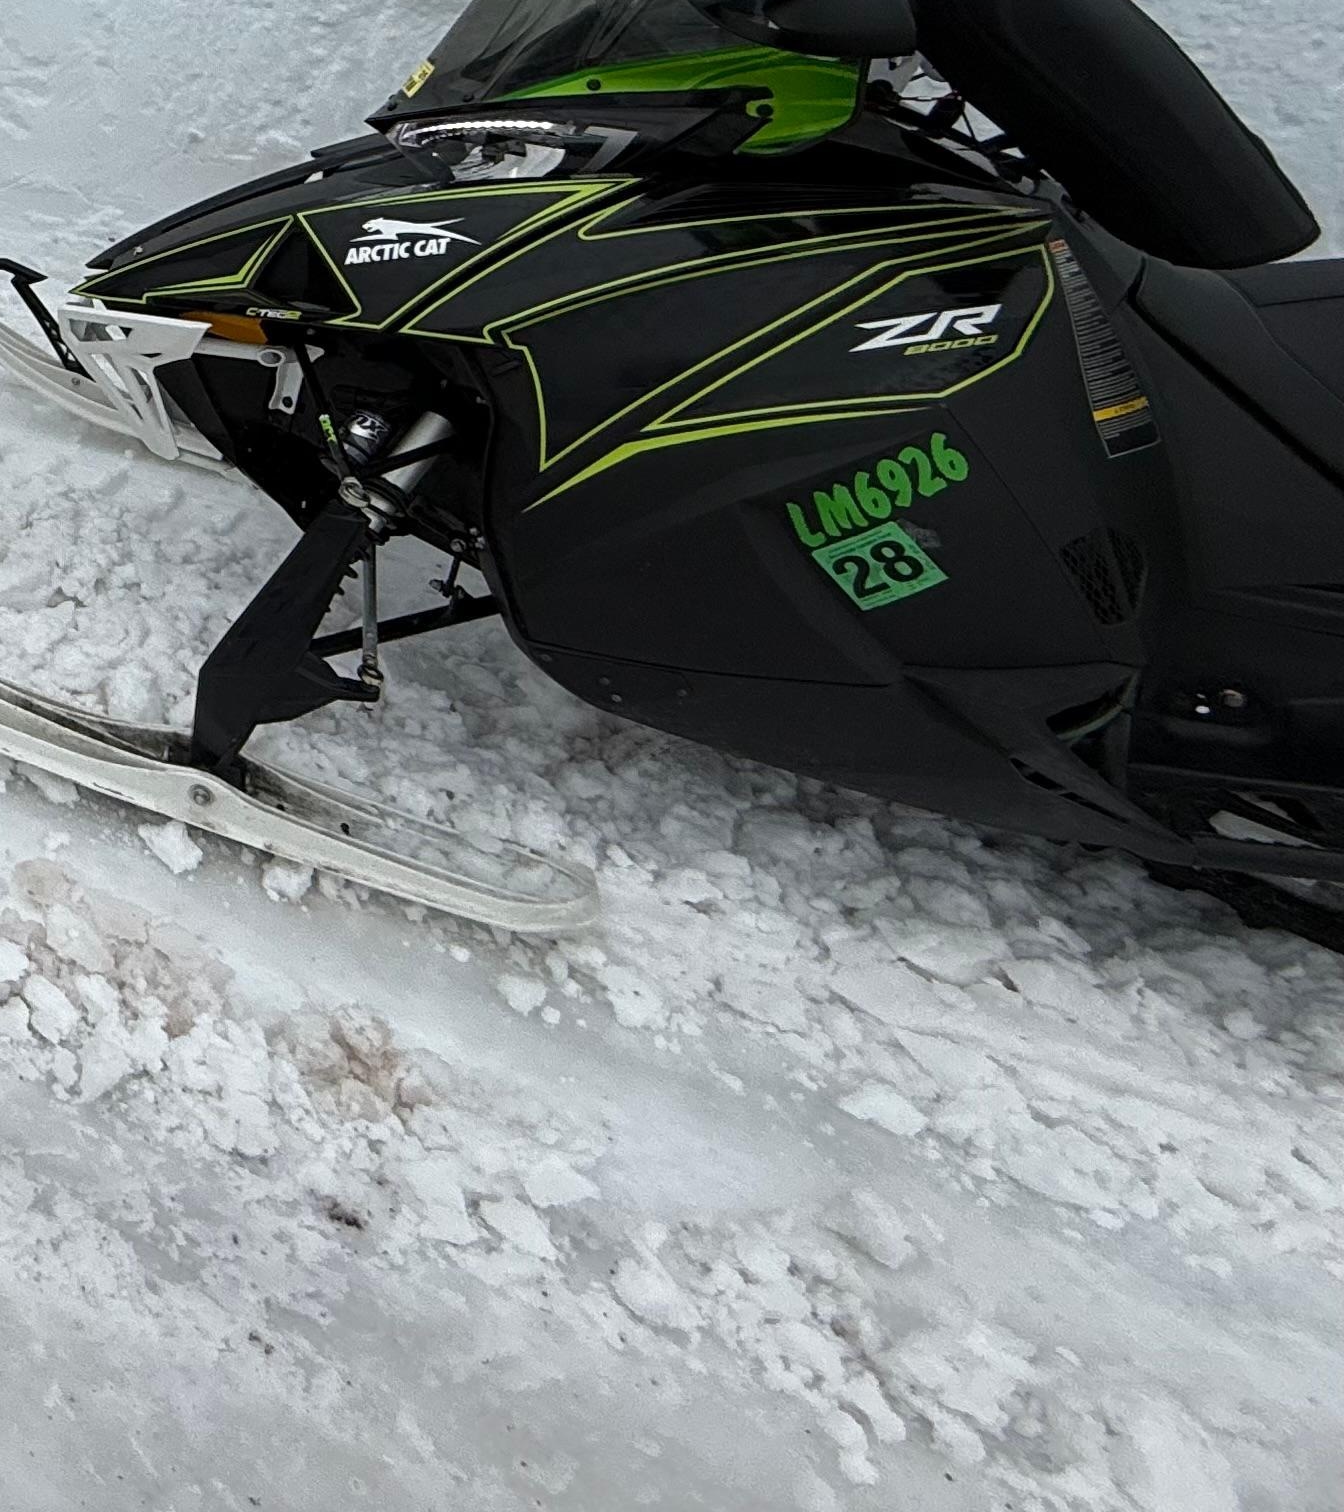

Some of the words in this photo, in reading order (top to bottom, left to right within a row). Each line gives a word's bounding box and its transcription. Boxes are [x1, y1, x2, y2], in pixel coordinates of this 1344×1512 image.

[344, 242, 411, 265] ARCTIC
[413, 237, 451, 257] CAT
[848, 303, 1002, 352] ZR
[786, 432, 969, 547] LM6926
[832, 540, 924, 599] 28
